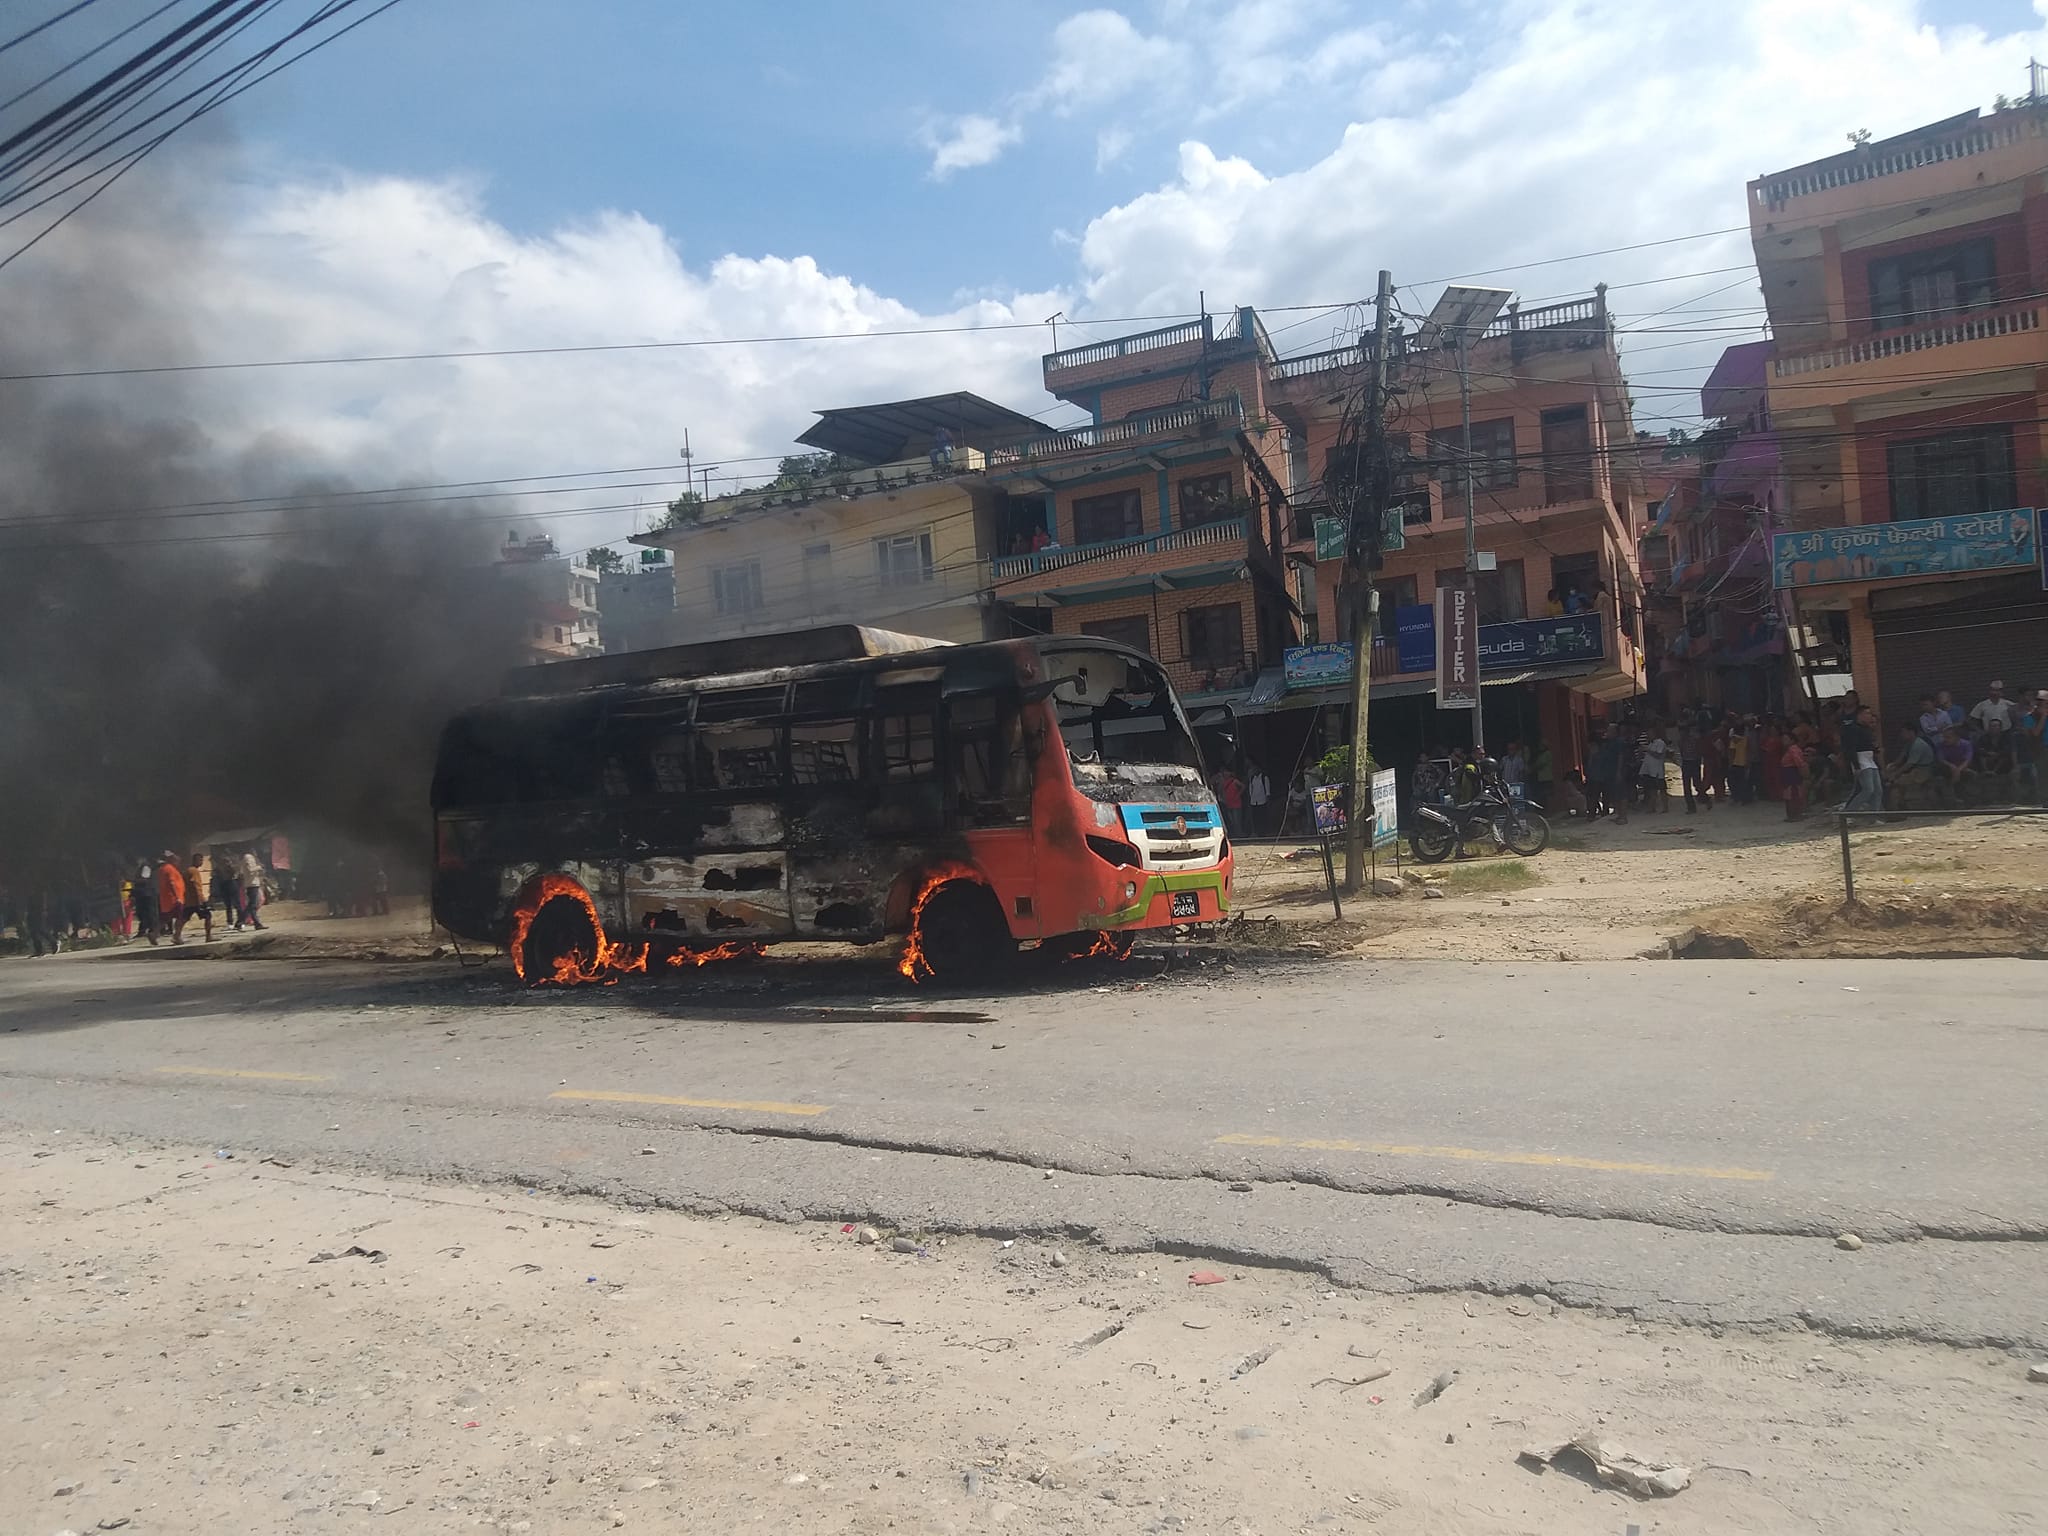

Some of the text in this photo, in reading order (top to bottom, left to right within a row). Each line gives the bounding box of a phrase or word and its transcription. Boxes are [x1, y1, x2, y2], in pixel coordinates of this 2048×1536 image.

[1801, 533, 1825, 554] श्री
[1399, 622, 1431, 632] HYUNDAI
[1453, 590, 1466, 683] BETTER
[1478, 639, 1525, 655] suda
